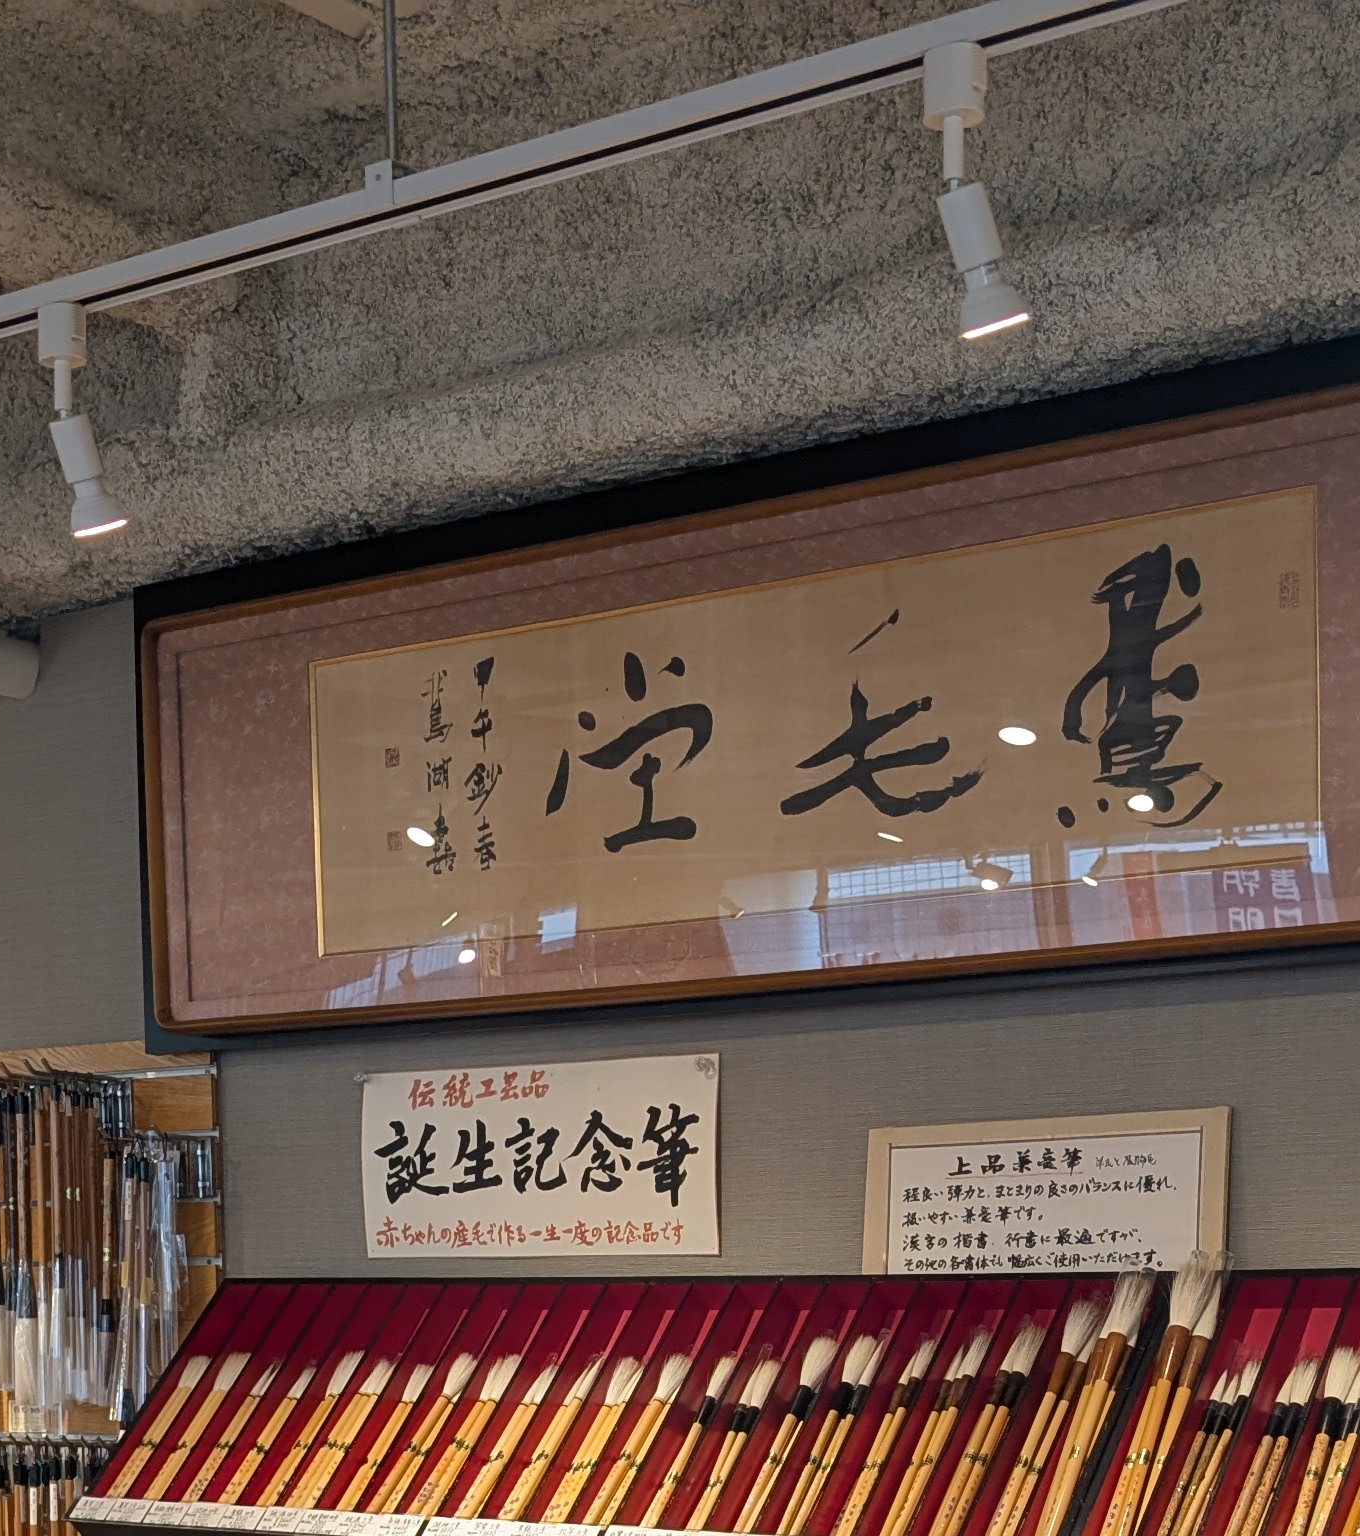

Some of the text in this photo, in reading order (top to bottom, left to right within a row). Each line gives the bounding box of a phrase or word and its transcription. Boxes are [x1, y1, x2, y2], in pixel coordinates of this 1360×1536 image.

[408, 1070, 550, 1111] 伝統工芸品
[373, 1102, 700, 1208] 誕生記念筆
[948, 1148, 1083, 1177] 上品兼毫筆
[376, 1217, 685, 1250] 赤ちゃんの産毛で作る一生一度の記念品です
